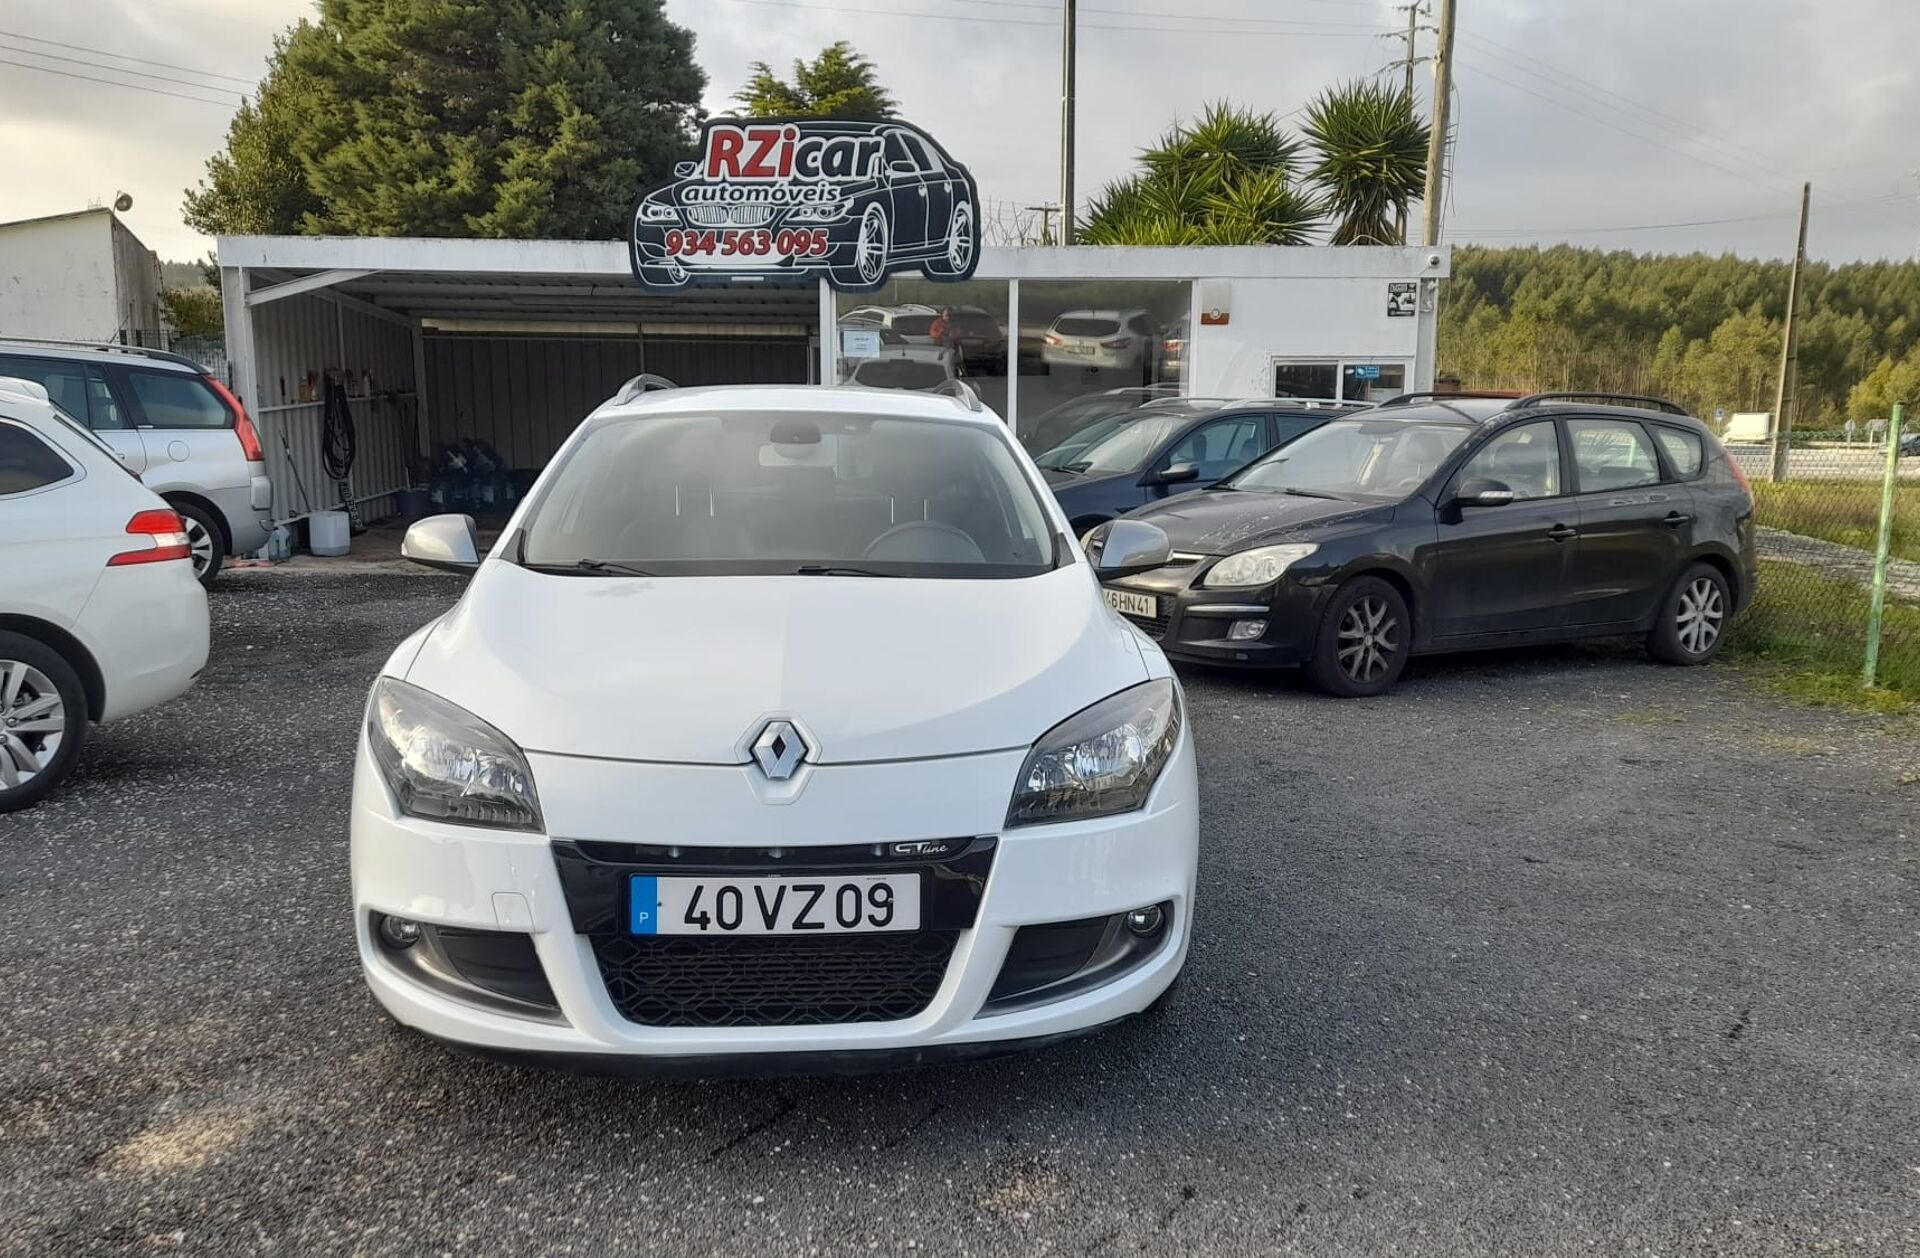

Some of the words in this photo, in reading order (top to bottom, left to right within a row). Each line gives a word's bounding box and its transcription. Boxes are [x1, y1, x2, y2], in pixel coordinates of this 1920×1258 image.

[683, 182, 839, 203] automóveis
[666, 230, 716, 256] 934
[721, 230, 771, 256] 563
[777, 230, 828, 256] 095
[639, 911, 649, 924] P
